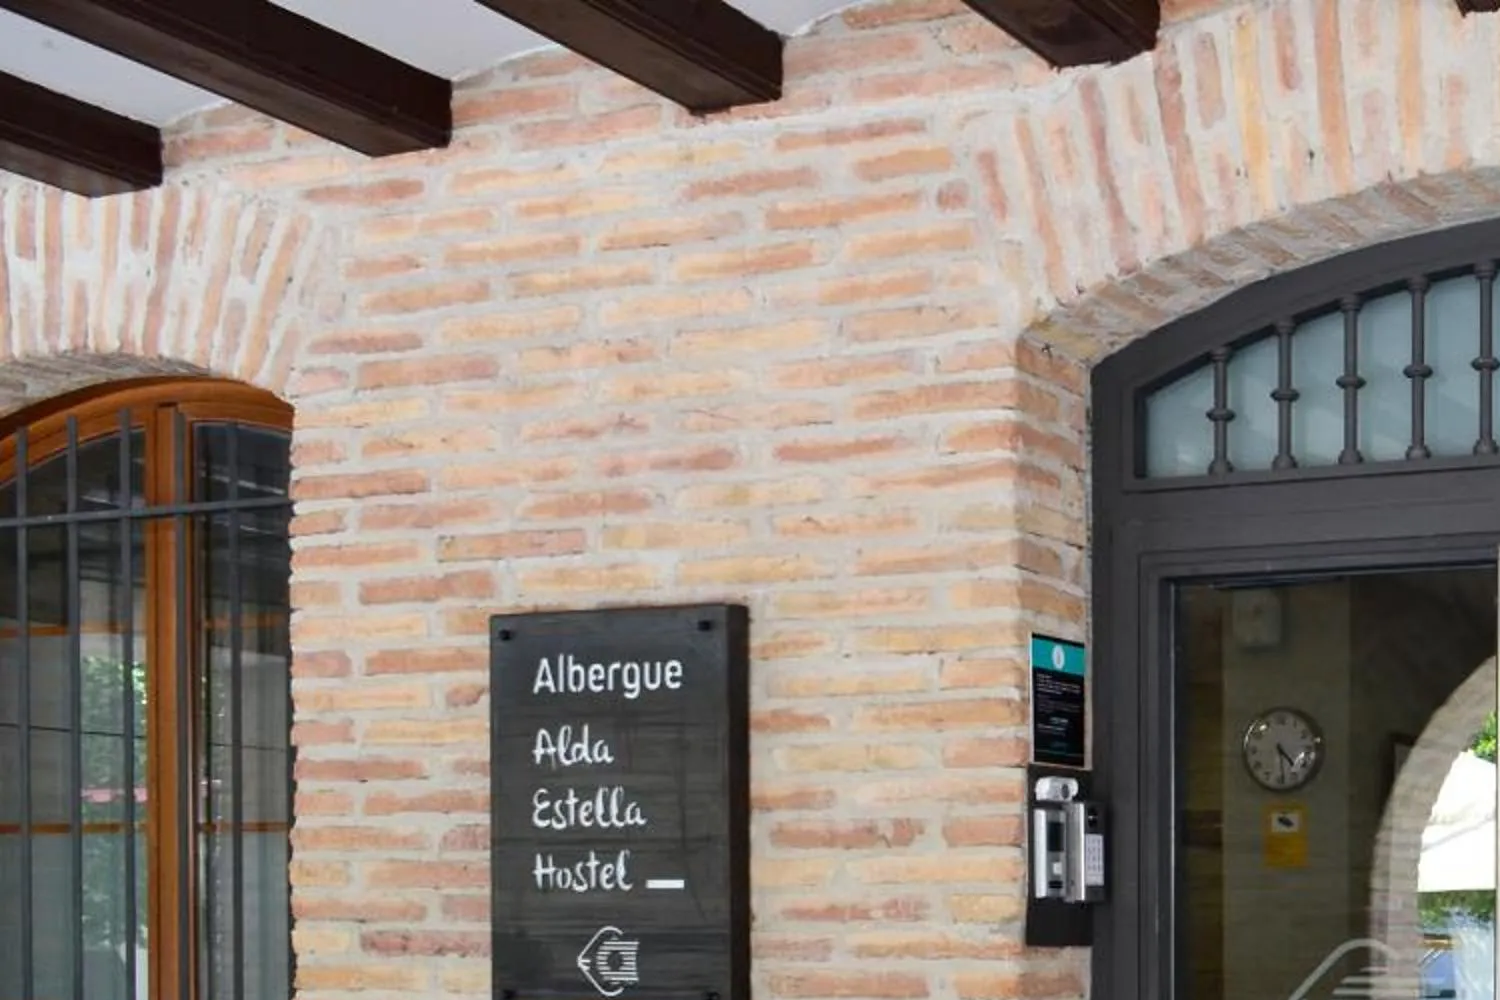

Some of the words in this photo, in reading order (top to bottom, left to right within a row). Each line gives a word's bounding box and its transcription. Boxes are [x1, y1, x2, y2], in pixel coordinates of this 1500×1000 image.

[532, 653, 684, 699] Albergue
[532, 723, 615, 768] Alda
[532, 785, 648, 830] Estella
[532, 848, 634, 892] Hostel
